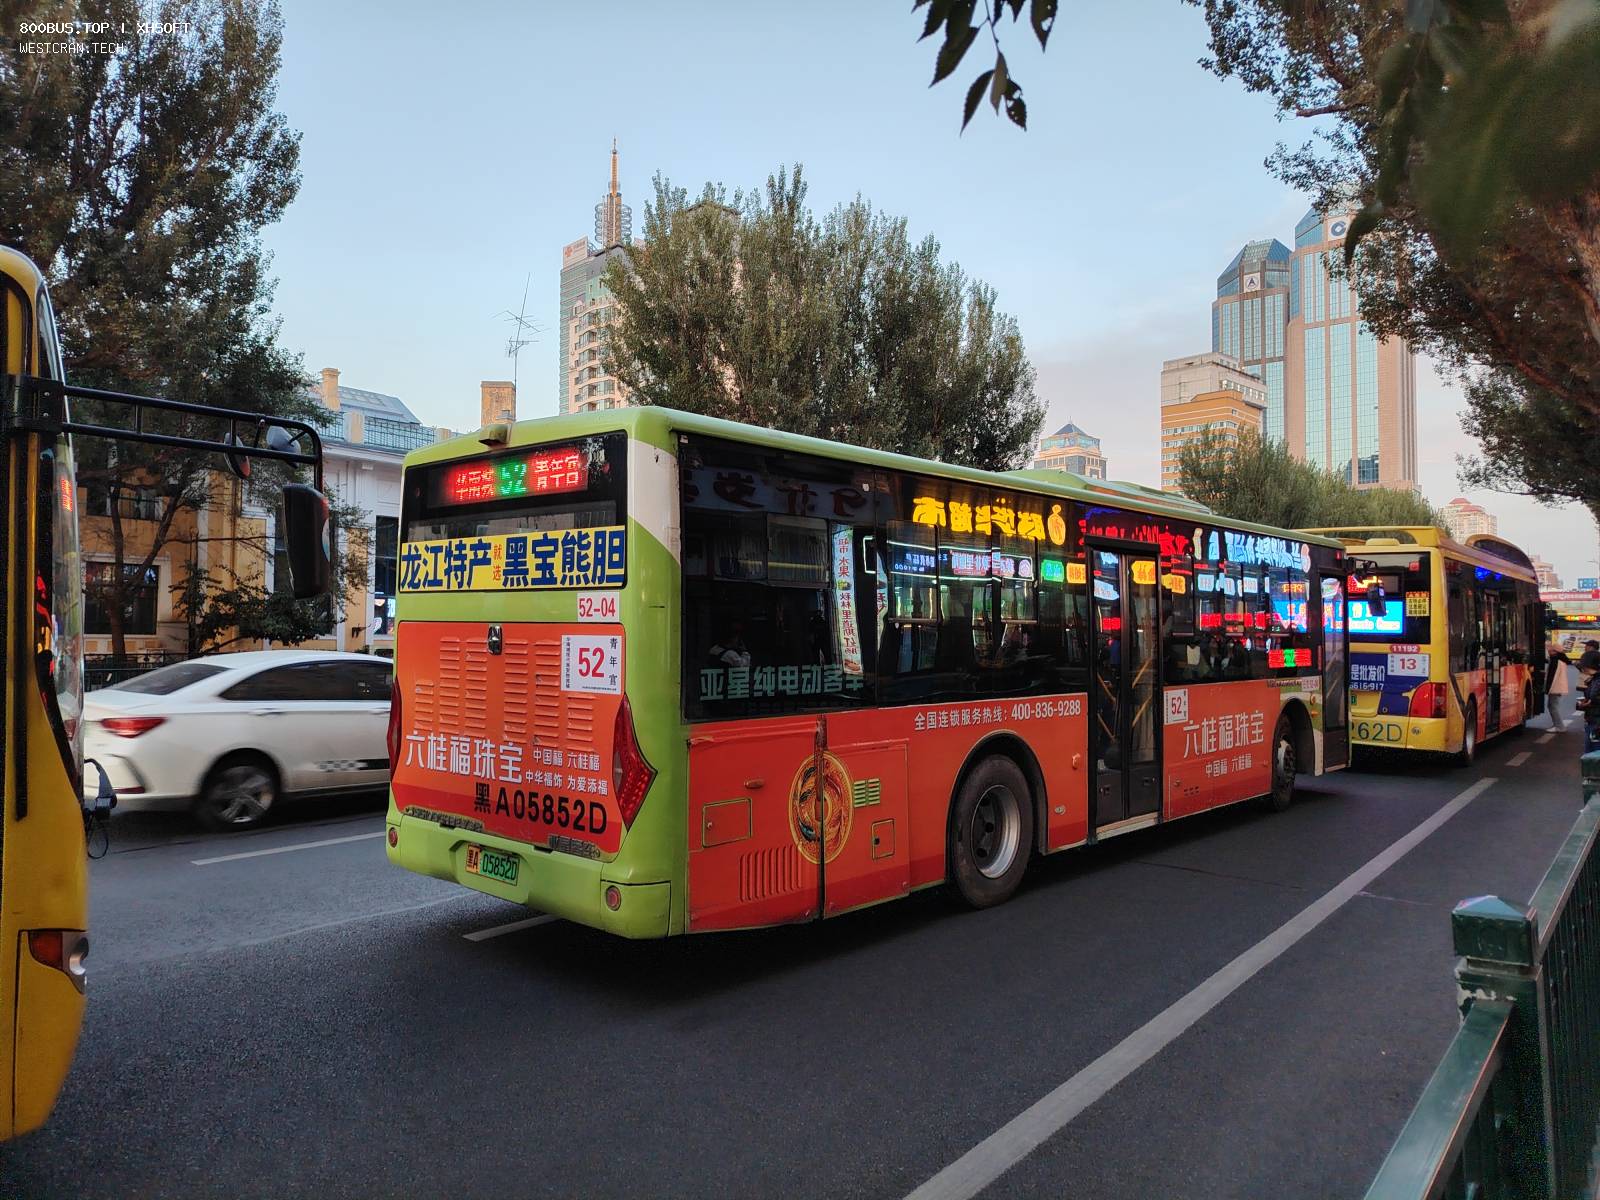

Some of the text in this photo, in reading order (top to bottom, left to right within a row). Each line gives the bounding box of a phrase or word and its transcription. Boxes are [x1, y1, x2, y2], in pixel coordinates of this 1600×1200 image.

[400, 539, 491, 590] 龙江特产
[502, 529, 625, 588] 黑宝熊胆
[578, 596, 616, 618] 52-04
[578, 646, 605, 678] 52
[1399, 658, 1417, 670] 13
[1171, 696, 1182, 715] 52
[1183, 710, 1265, 759] 六桂福珠宝
[405, 730, 523, 784] 六桂福珠宝
[532, 747, 601, 772] 中国福 六桂福
[524, 768, 609, 796] 中华福饰 为爱添福
